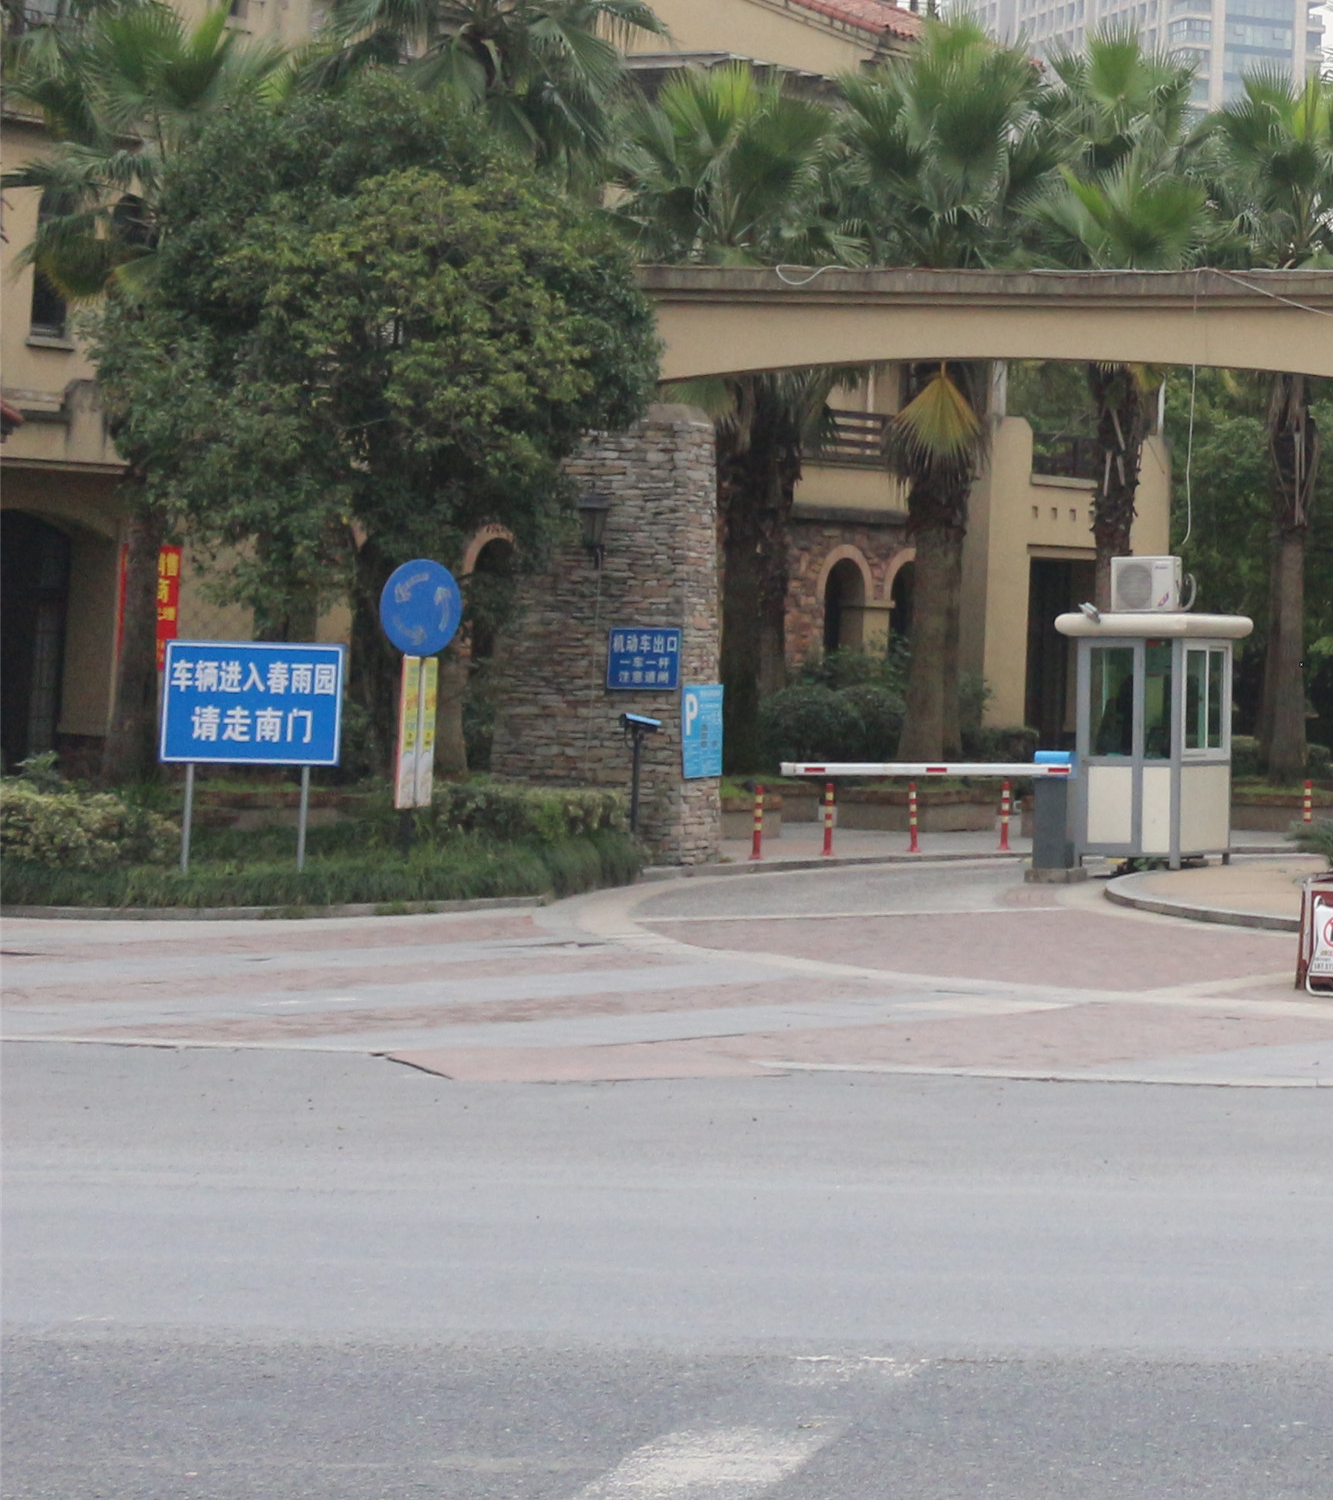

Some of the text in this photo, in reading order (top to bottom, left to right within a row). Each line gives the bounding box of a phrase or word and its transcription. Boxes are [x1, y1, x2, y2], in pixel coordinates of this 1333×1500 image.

[613, 634, 678, 654] 机动车出口
[171, 659, 337, 696] 车辆进入春雨园
[191, 705, 314, 744] 请走南门
[686, 693, 698, 736] P
